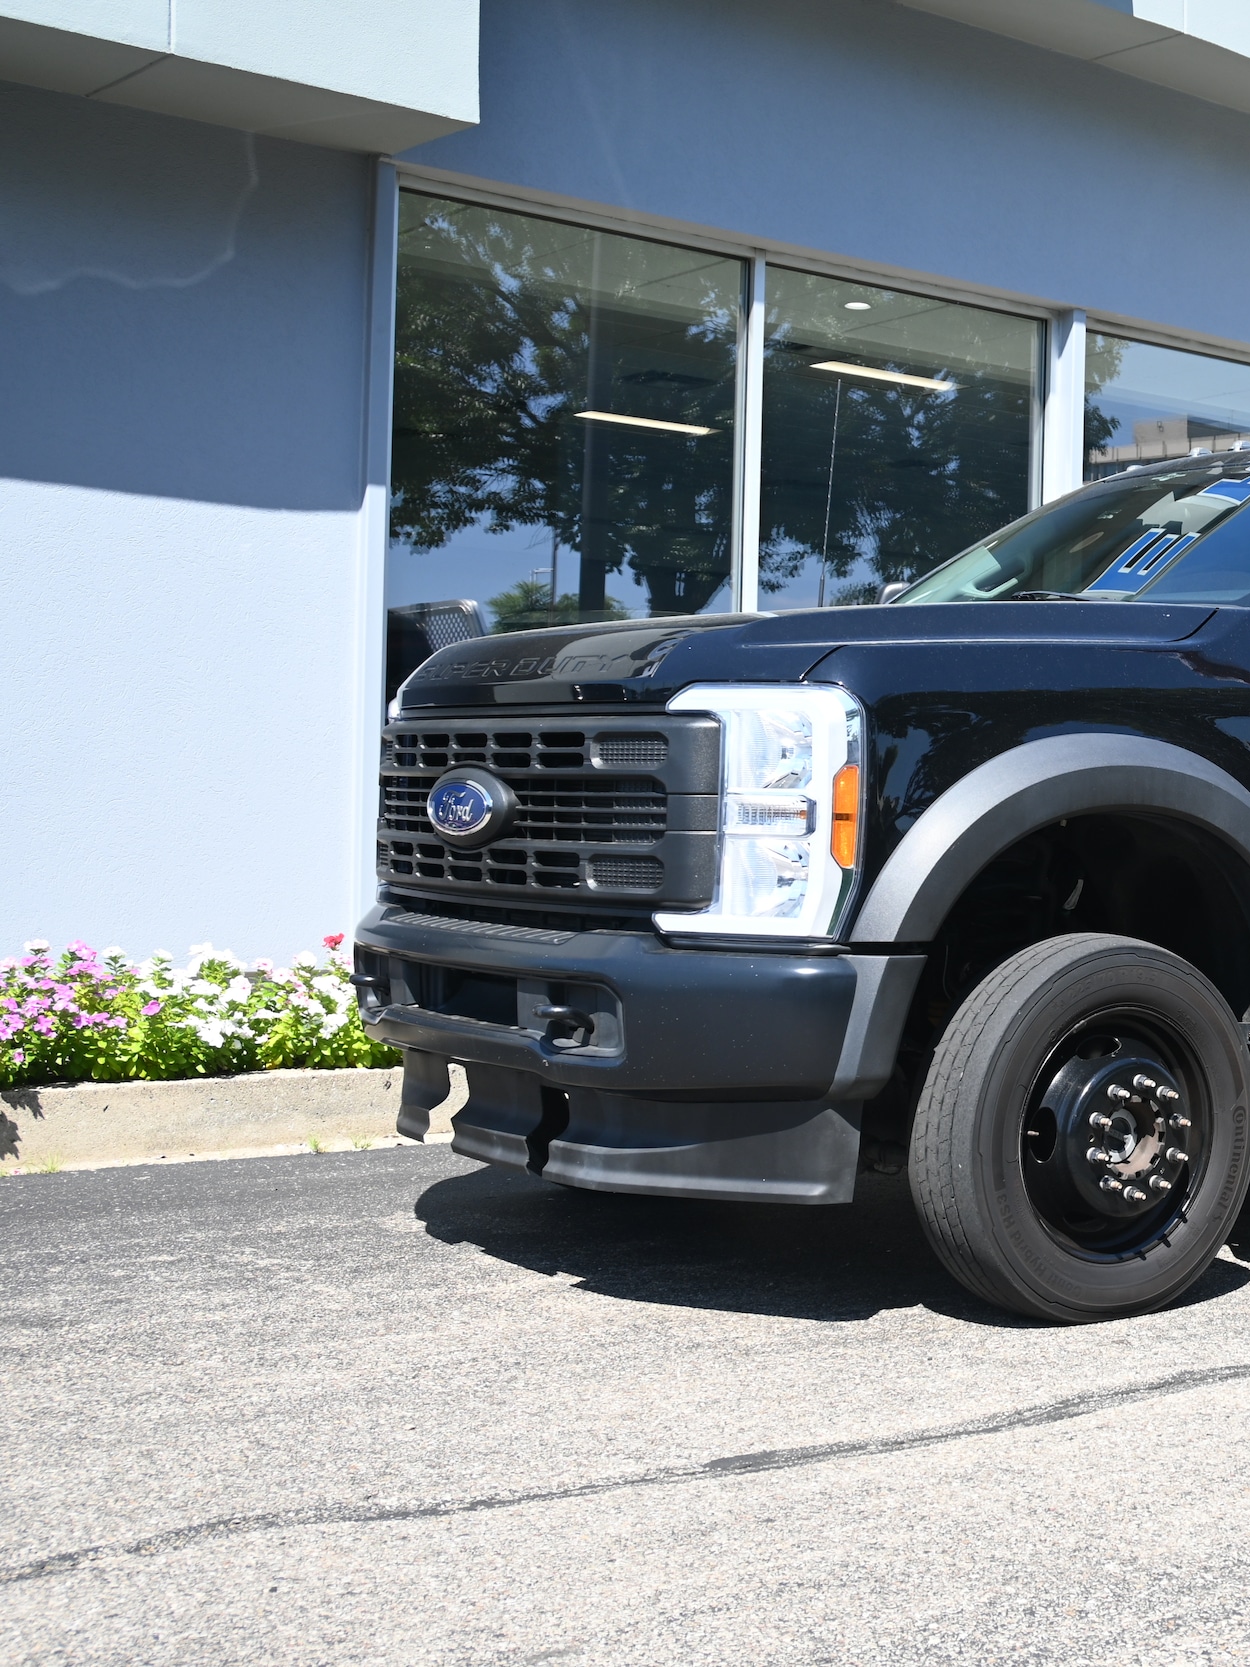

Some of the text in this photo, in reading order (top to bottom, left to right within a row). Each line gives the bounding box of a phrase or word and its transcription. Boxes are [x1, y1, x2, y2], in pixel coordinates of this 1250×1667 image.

[417, 653, 632, 680] SUPER DUTY
[438, 789, 475, 822] Ford
[1216, 1105, 1247, 1210] Continental
[996, 1193, 1083, 1299] Conti Hybrid HS3
